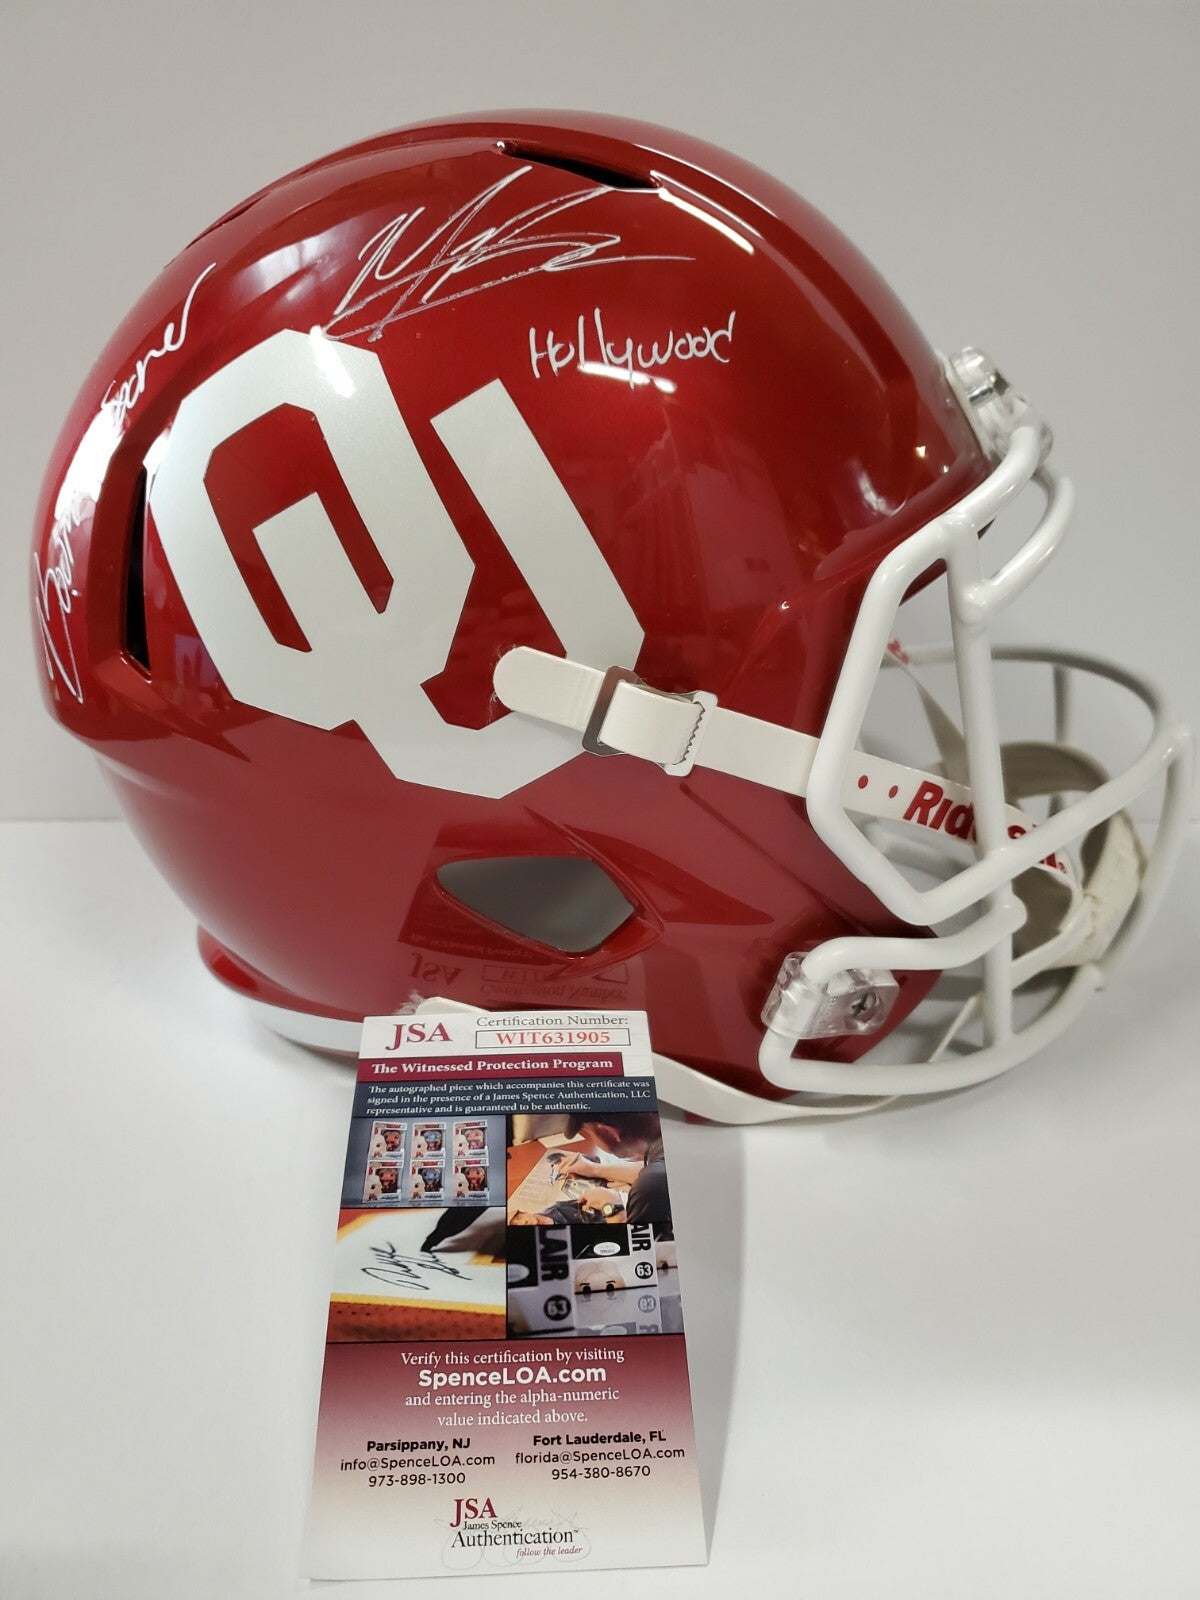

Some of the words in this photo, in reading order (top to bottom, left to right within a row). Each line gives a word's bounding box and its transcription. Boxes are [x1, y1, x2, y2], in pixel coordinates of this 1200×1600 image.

[529, 307, 737, 389] Hollywood
[476, 1015, 563, 1027] Certification
[567, 1014, 629, 1025] Number:
[385, 1022, 453, 1050] JSA
[496, 1031, 611, 1045] WIT631905
[371, 1063, 398, 1074] The
[401, 1060, 473, 1073] Witnessed
[476, 1058, 549, 1071] Protection
[552, 1058, 613, 1071] Program
[368, 1085, 386, 1094] The
[388, 1083, 447, 1094] autographed
[449, 1084, 474, 1093] piece
[475, 1081, 504, 1091] which
[506, 1081, 565, 1091] accompanies
[567, 1079, 584, 1088] this
[586, 1079, 631, 1088] certificate
[632, 1080, 650, 1088] was
[367, 1095, 398, 1105] signed
[401, 1095, 411, 1103] in
[413, 1094, 429, 1103] the
[430, 1094, 471, 1104] presence
[473, 1092, 484, 1101] of
[493, 1092, 520, 1102] James
[522, 1092, 555, 1101] Spence
[557, 1090, 629, 1099] Authentication,
[631, 1090, 651, 1098] LLC
[366, 1106, 432, 1116] representative
[435, 1105, 453, 1113] and
[455, 1104, 463, 1112] is
[464, 1103, 517, 1114] guaranteed
[531, 1102, 543, 1110] be
[545, 1101, 591, 1110] authentic.
[636, 1263, 652, 1278] 63
[401, 1352, 441, 1368] Verify
[445, 1351, 469, 1364] this
[473, 1350, 552, 1364] certification
[556, 1348, 572, 1365] by
[575, 1348, 625, 1363] visiting
[418, 1366, 607, 1390] SpenceLOA.com
[405, 1392, 431, 1406] and
[435, 1392, 492, 1408] entering
[495, 1390, 517, 1403] the
[520, 1388, 620, 1406] alpha-numeric
[437, 1412, 474, 1426] value
[477, 1410, 541, 1425] indicated
[544, 1409, 588, 1423] above.
[367, 1439, 448, 1452] Parsippany,
[452, 1438, 471, 1449] NJ
[533, 1434, 561, 1446] Fort
[565, 1432, 646, 1445] Lauderdale,
[649, 1430, 667, 1442] FL
[340, 1455, 495, 1471] info@SpenceLOA.com
[515, 1448, 685, 1464] florida@SpenceLOA.com
[368, 1472, 466, 1487] 973-898-1300
[551, 1465, 651, 1480] 954-380-8670
[450, 1497, 498, 1527] JSA
[462, 1520, 489, 1531] James
[491, 1519, 522, 1530] Spence
[516, 1547, 541, 1558] follow
[543, 1546, 555, 1556] the
[558, 1545, 583, 1556] leader
